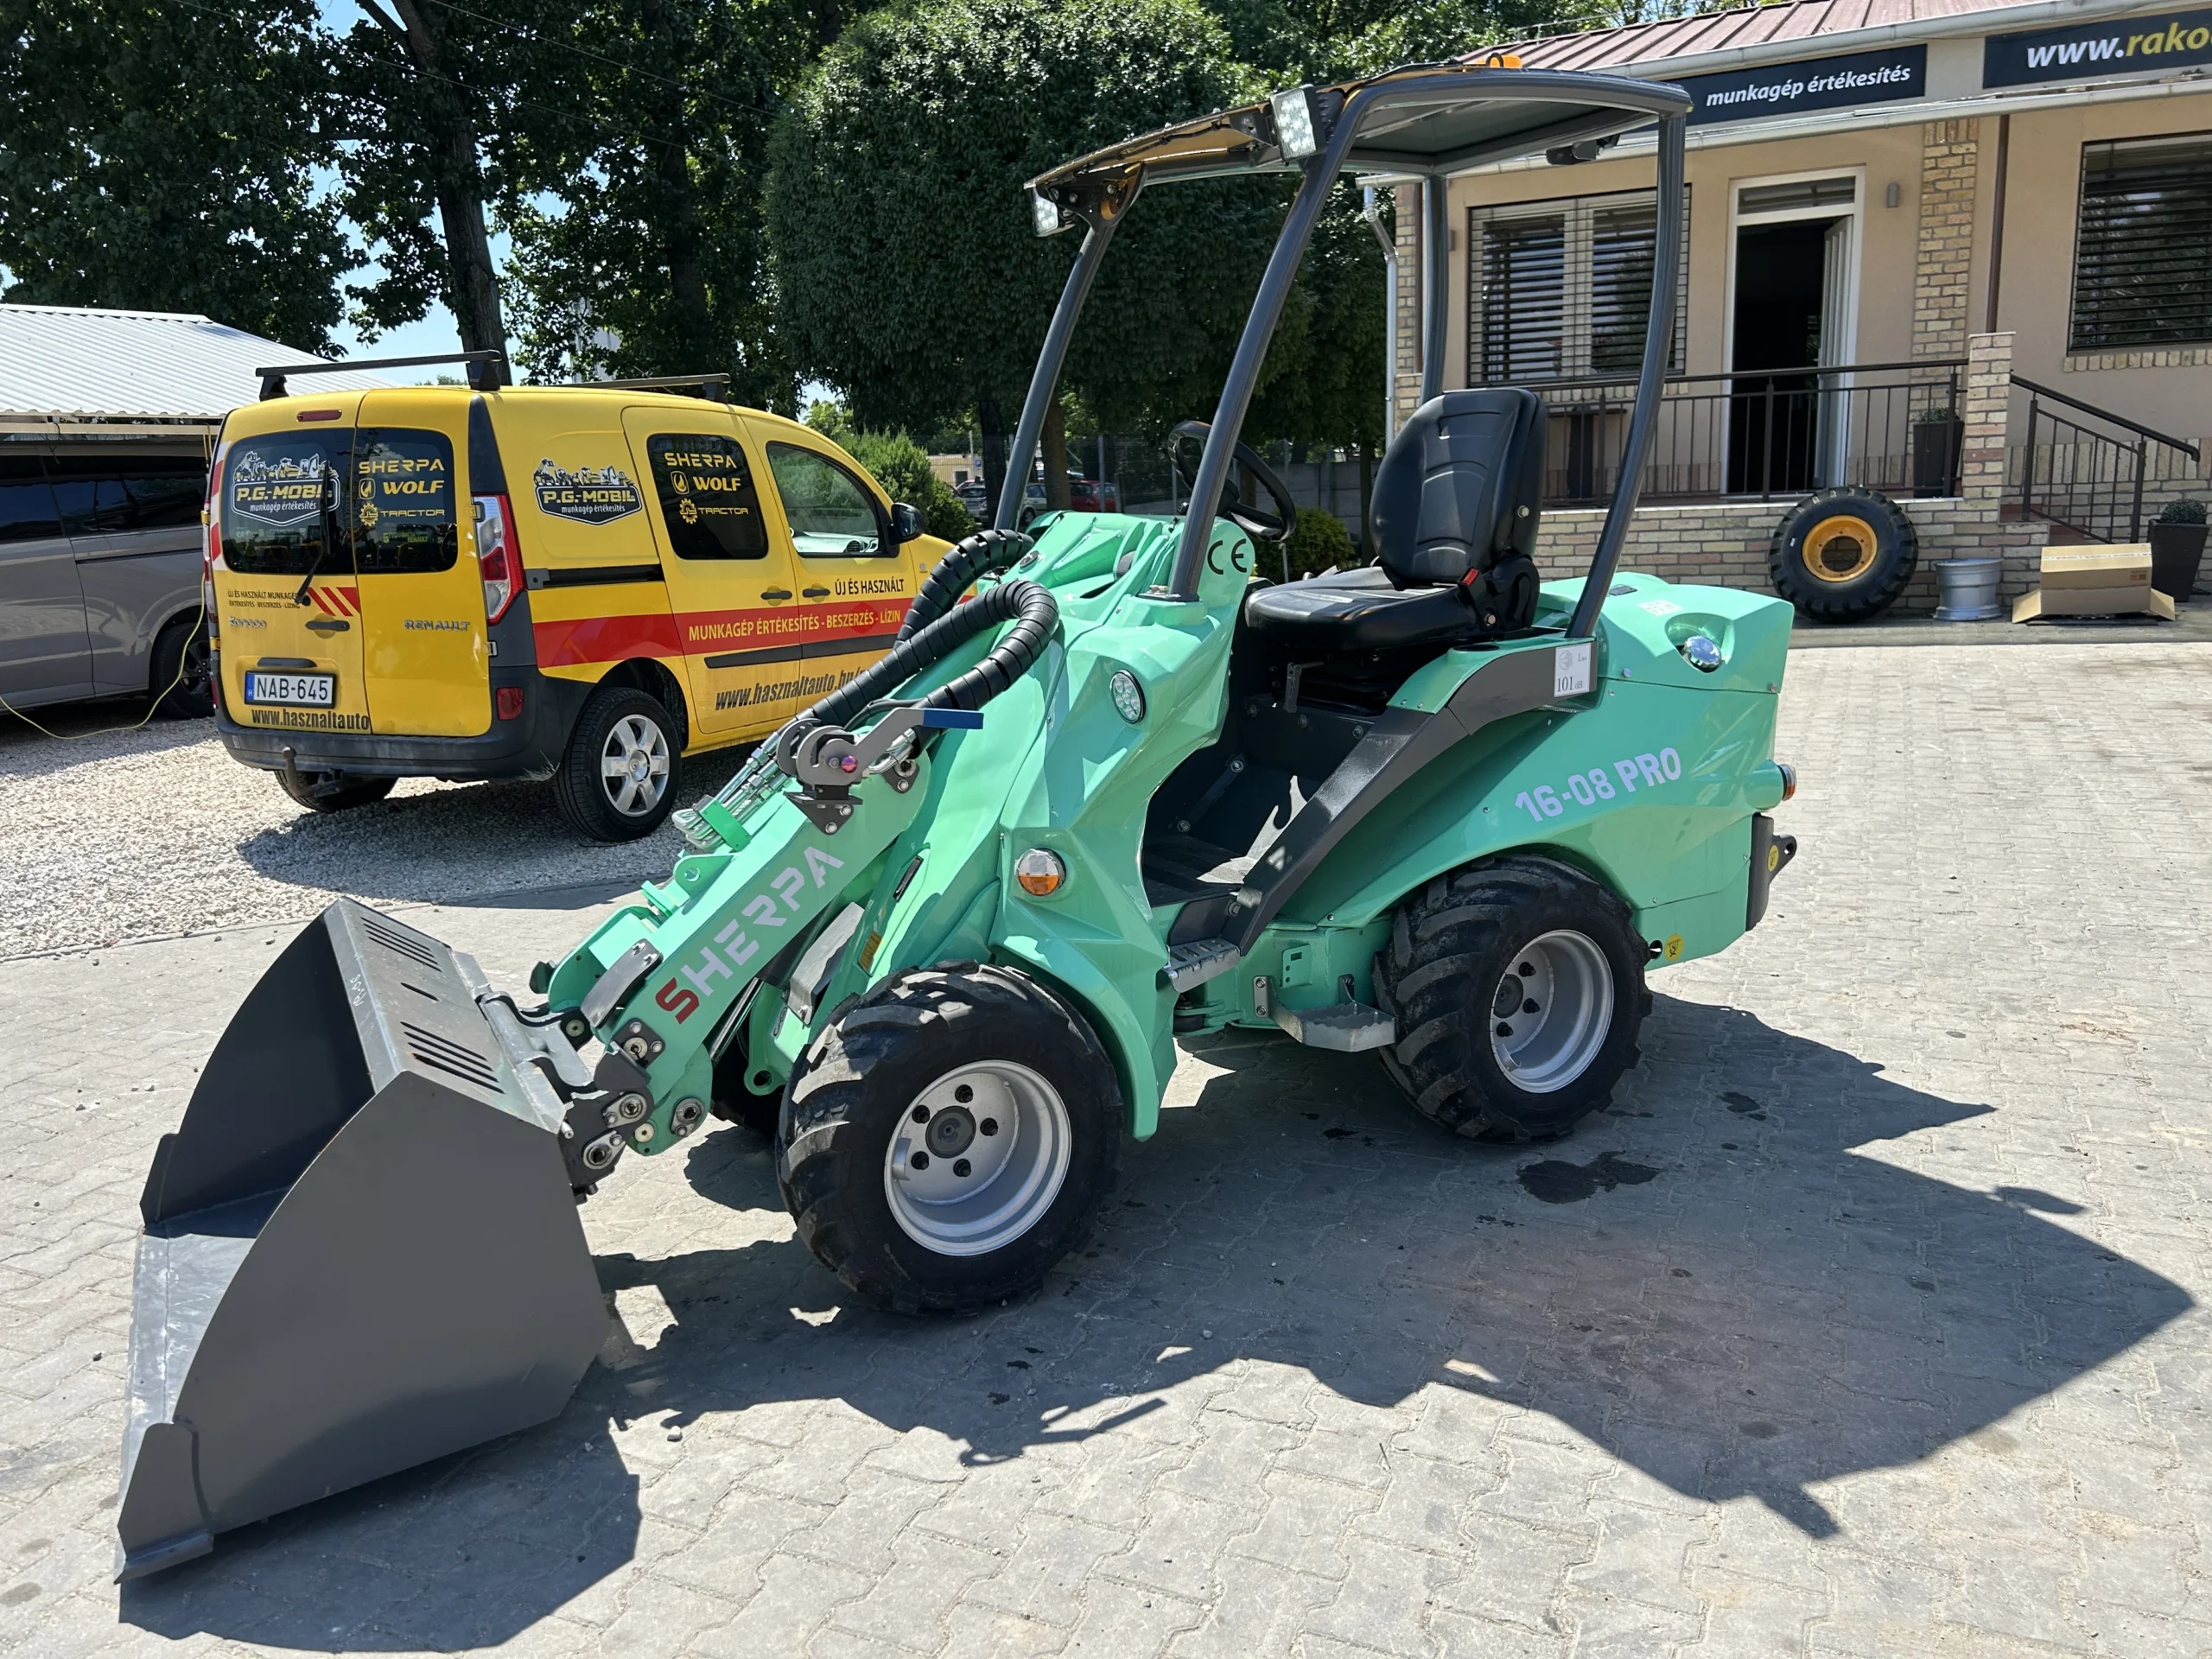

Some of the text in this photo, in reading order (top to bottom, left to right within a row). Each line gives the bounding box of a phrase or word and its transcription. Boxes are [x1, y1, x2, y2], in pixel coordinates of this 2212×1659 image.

[2027, 22, 2212, 68] www.rako
[1706, 65, 1910, 106] munkagép értékesítés
[359, 459, 445, 474] SHERPA
[664, 452, 737, 468] SHERPA
[383, 480, 445, 494] WOLF
[692, 476, 741, 491] WOLF
[542, 490, 636, 503] P.G.-MOBIL
[250, 500, 316, 512] munkagép értékesítés
[561, 503, 626, 514] munkagép értékesítés
[1207, 538, 1247, 575] CE
[234, 589, 240, 598] ÉS
[241, 590, 266, 599] HASZNÁLT
[835, 578, 905, 595] ÚJ ÉS HASZNÁLT
[404, 620, 471, 632] RENAULT
[689, 620, 754, 641] MUNKAGÉP
[756, 613, 820, 636] ÉRTÉKESÍTÉS
[826, 609, 874, 629] BESZERZÉS
[257, 677, 328, 701] NAB-645
[1557, 676, 1573, 692] 101
[251, 709, 370, 730] www.hasznaltauto
[1515, 747, 1681, 822] 16-08 PRO
[655, 846, 844, 1025] SHERPA
